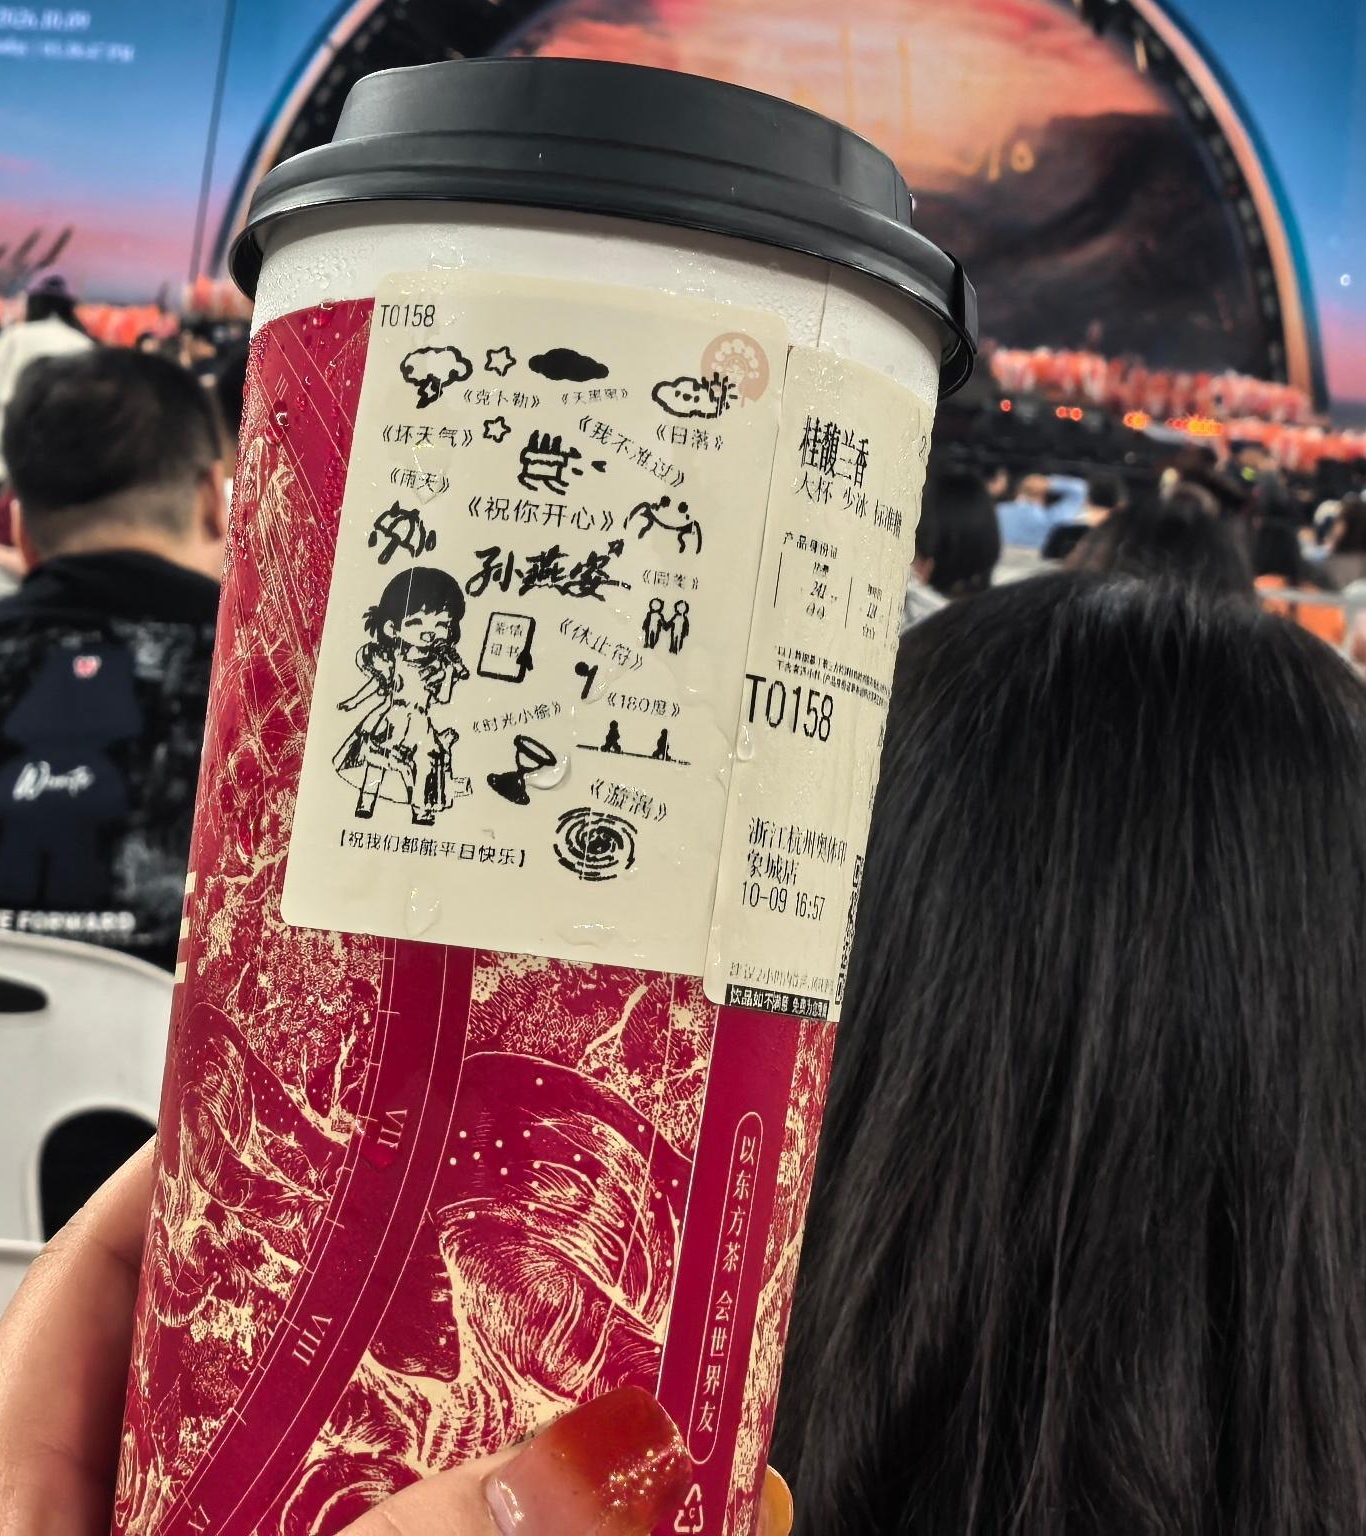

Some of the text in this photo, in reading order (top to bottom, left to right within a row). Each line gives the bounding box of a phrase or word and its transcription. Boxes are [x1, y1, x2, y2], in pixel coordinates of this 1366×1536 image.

[380, 304, 435, 328] T0158
[382, 424, 473, 447] 《坏天气》
[390, 467, 450, 493] 《雨天》
[795, 471, 833, 505] 大杯
[843, 487, 869, 518] 少冰
[468, 496, 614, 531] 《祝你开心》
[745, 674, 834, 742] T0158
[742, 881, 826, 921] 10-09 16:57
[696, 1136, 756, 1433] 以东方茶 会世界友
